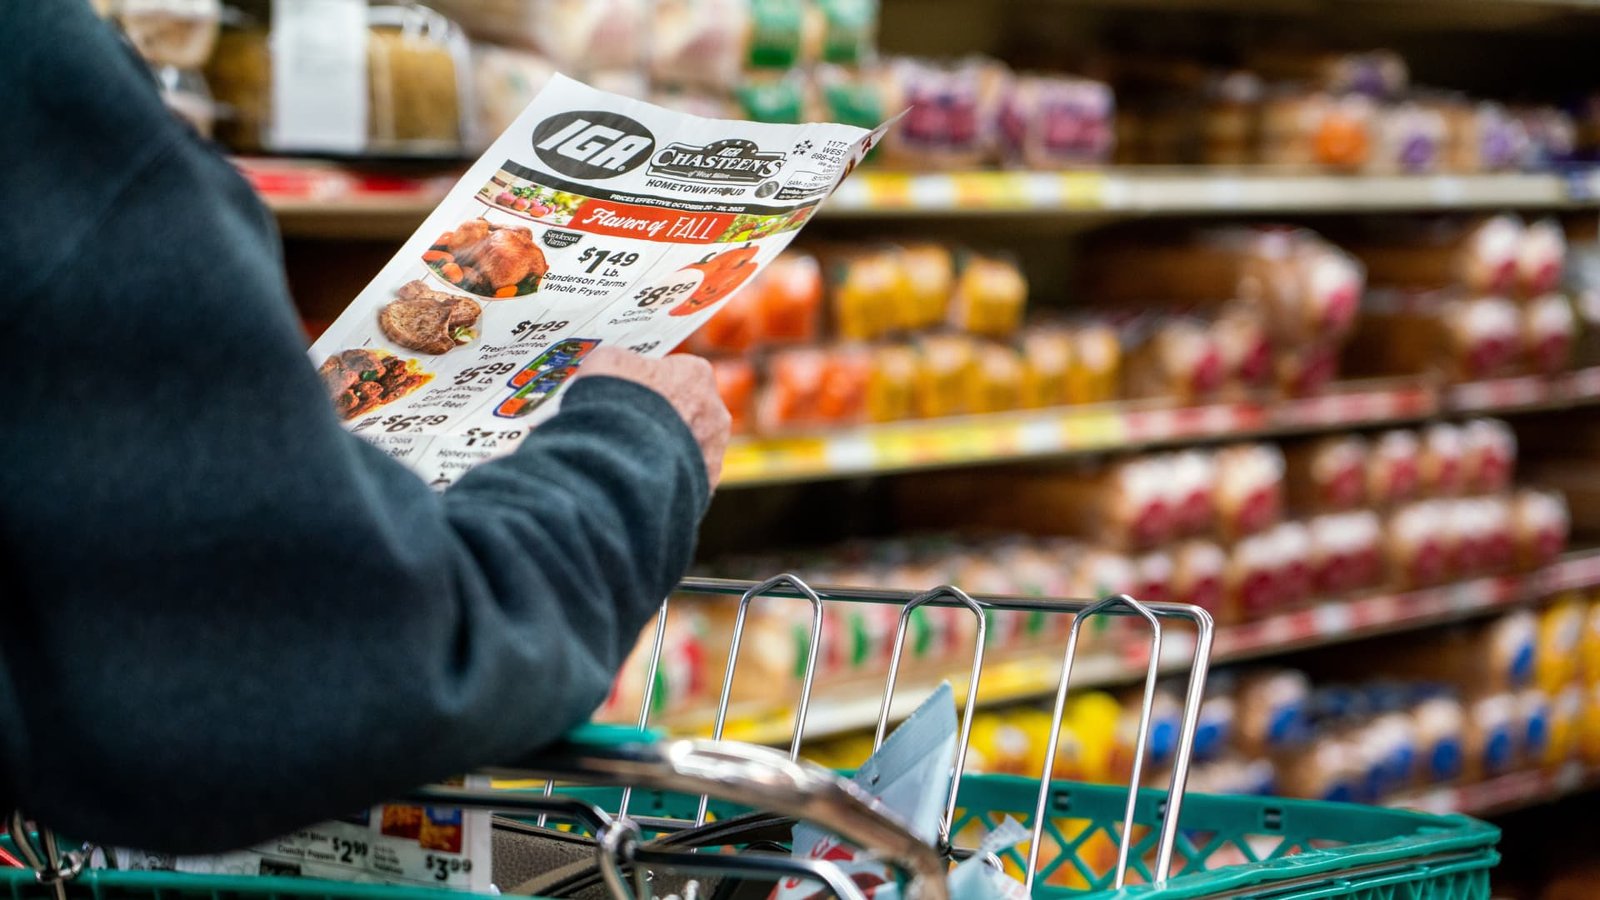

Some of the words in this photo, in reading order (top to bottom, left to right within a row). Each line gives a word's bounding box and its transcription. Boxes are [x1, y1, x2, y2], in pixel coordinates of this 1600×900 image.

[536, 119, 653, 171] IGA
[826, 140, 848, 148] 1177
[651, 148, 787, 178] CHASTEEN'S
[646, 179, 708, 195] HOMETOWN
[610, 193, 633, 202] PRICES
[634, 196, 671, 207] EFFECTIVE
[671, 201, 703, 211] OCTOBER
[582, 207, 649, 231] Flavors
[647, 219, 669, 237] of
[666, 216, 718, 240] FALL
[545, 231, 579, 243] Sanderson
[543, 272, 596, 285] Sanderson
[596, 278, 628, 288] Farms
[603, 268, 620, 277] Lb.
[544, 283, 576, 294] Whole
[577, 287, 610, 297] Fryers
